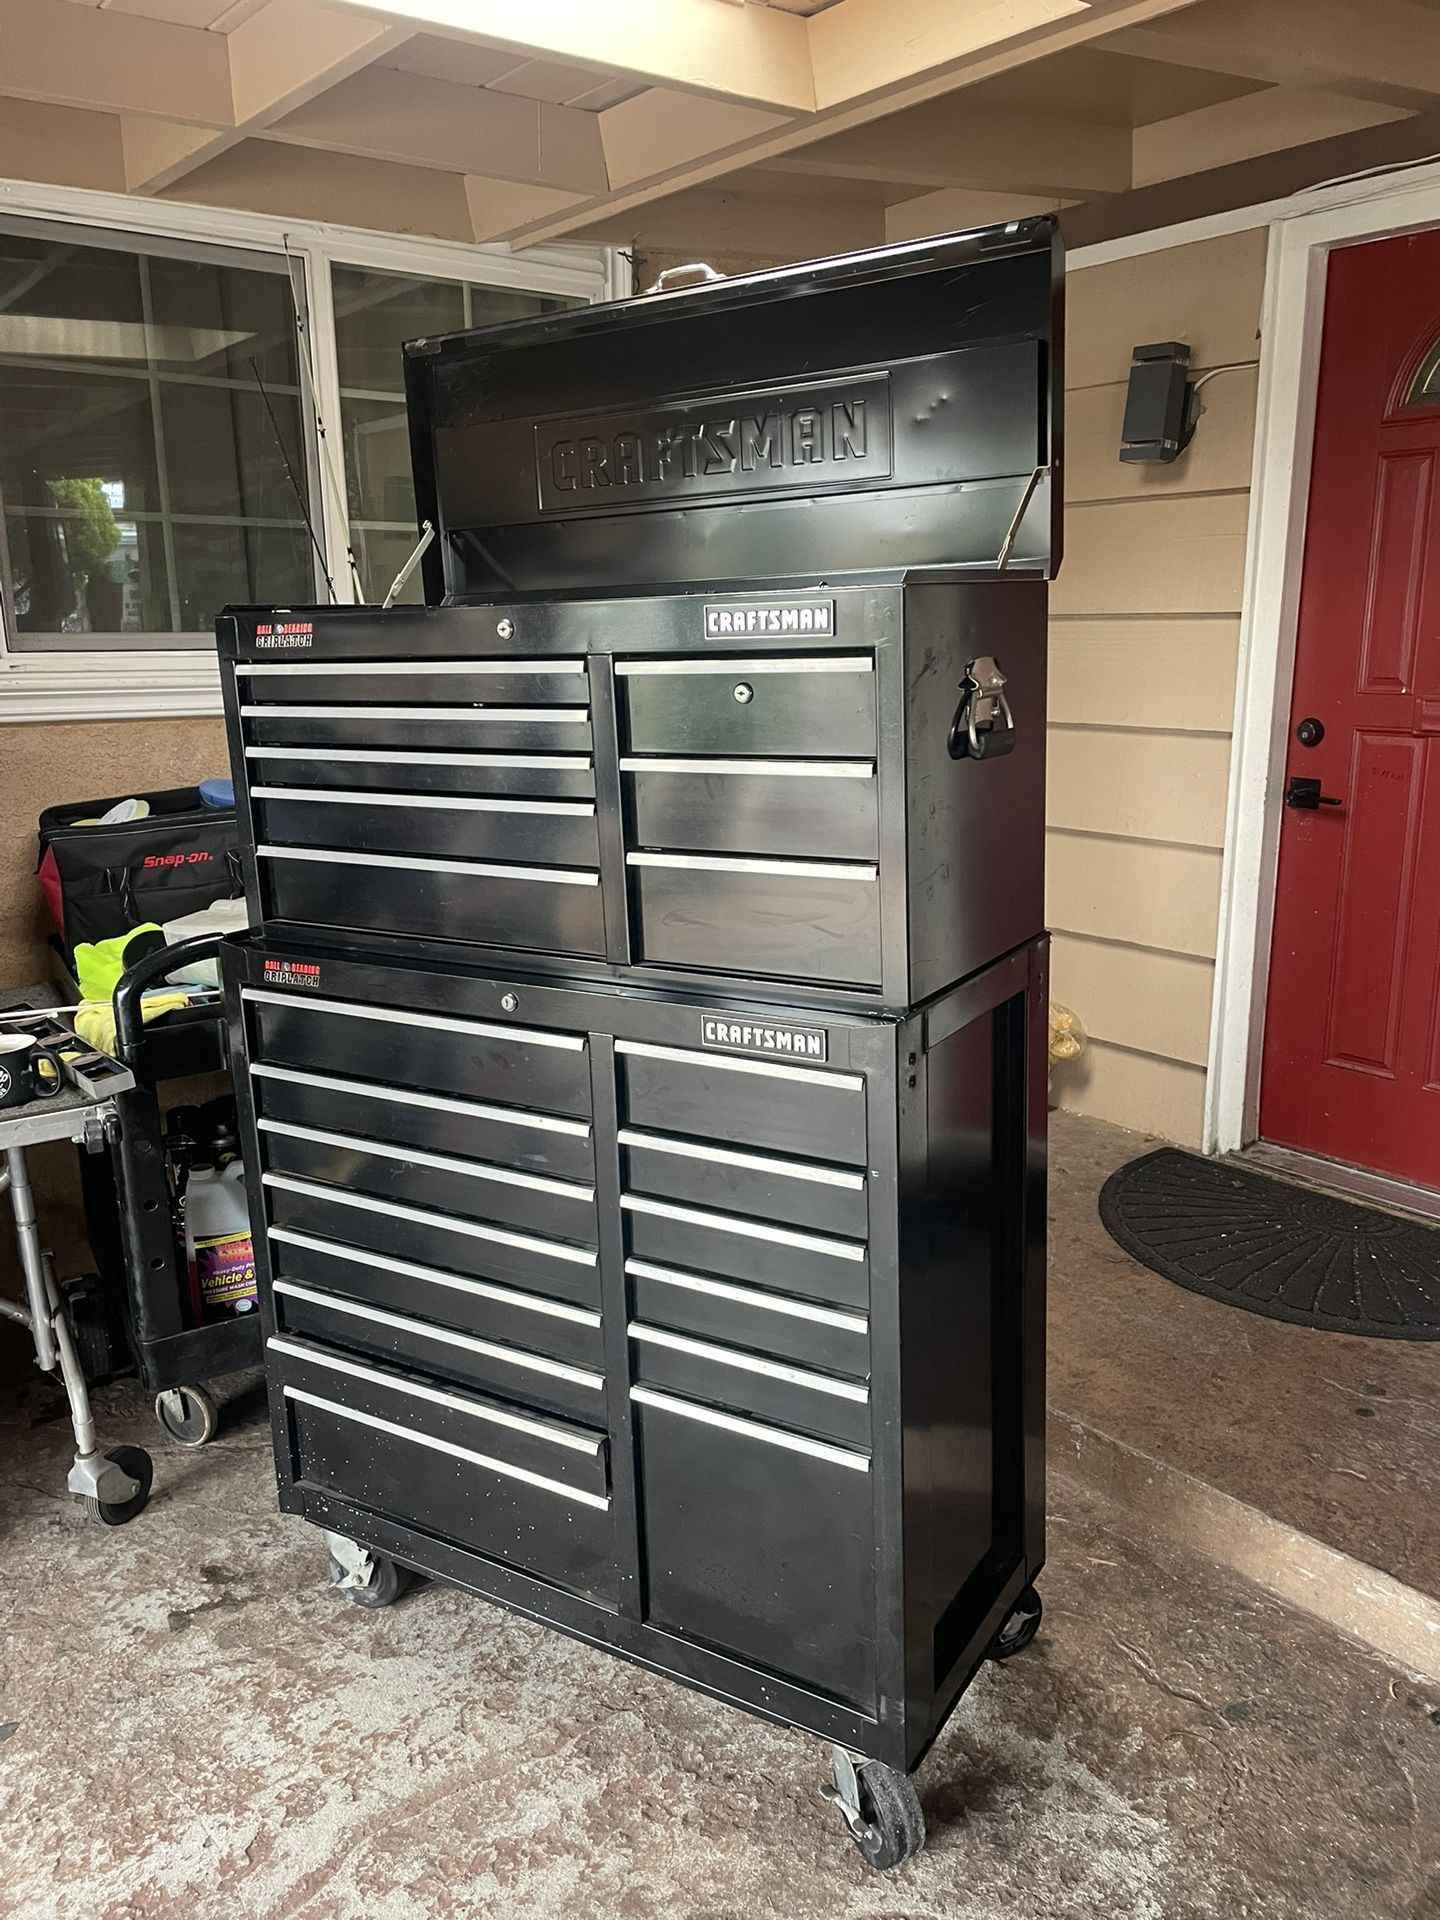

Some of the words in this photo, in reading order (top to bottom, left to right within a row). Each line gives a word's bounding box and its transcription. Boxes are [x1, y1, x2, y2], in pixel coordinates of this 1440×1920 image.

[551, 399, 868, 491] CRAFTSMAN
[708, 607, 829, 632] CRAFTSMAN
[255, 633, 313, 648] GRIPLATCH
[263, 970, 320, 988] GRIPLATCH
[705, 1021, 821, 1055] CRAFTSMAN
[201, 1272, 243, 1289] Vehicle
[244, 1269, 254, 1280] &
[229, 1282, 245, 1291] WASH
